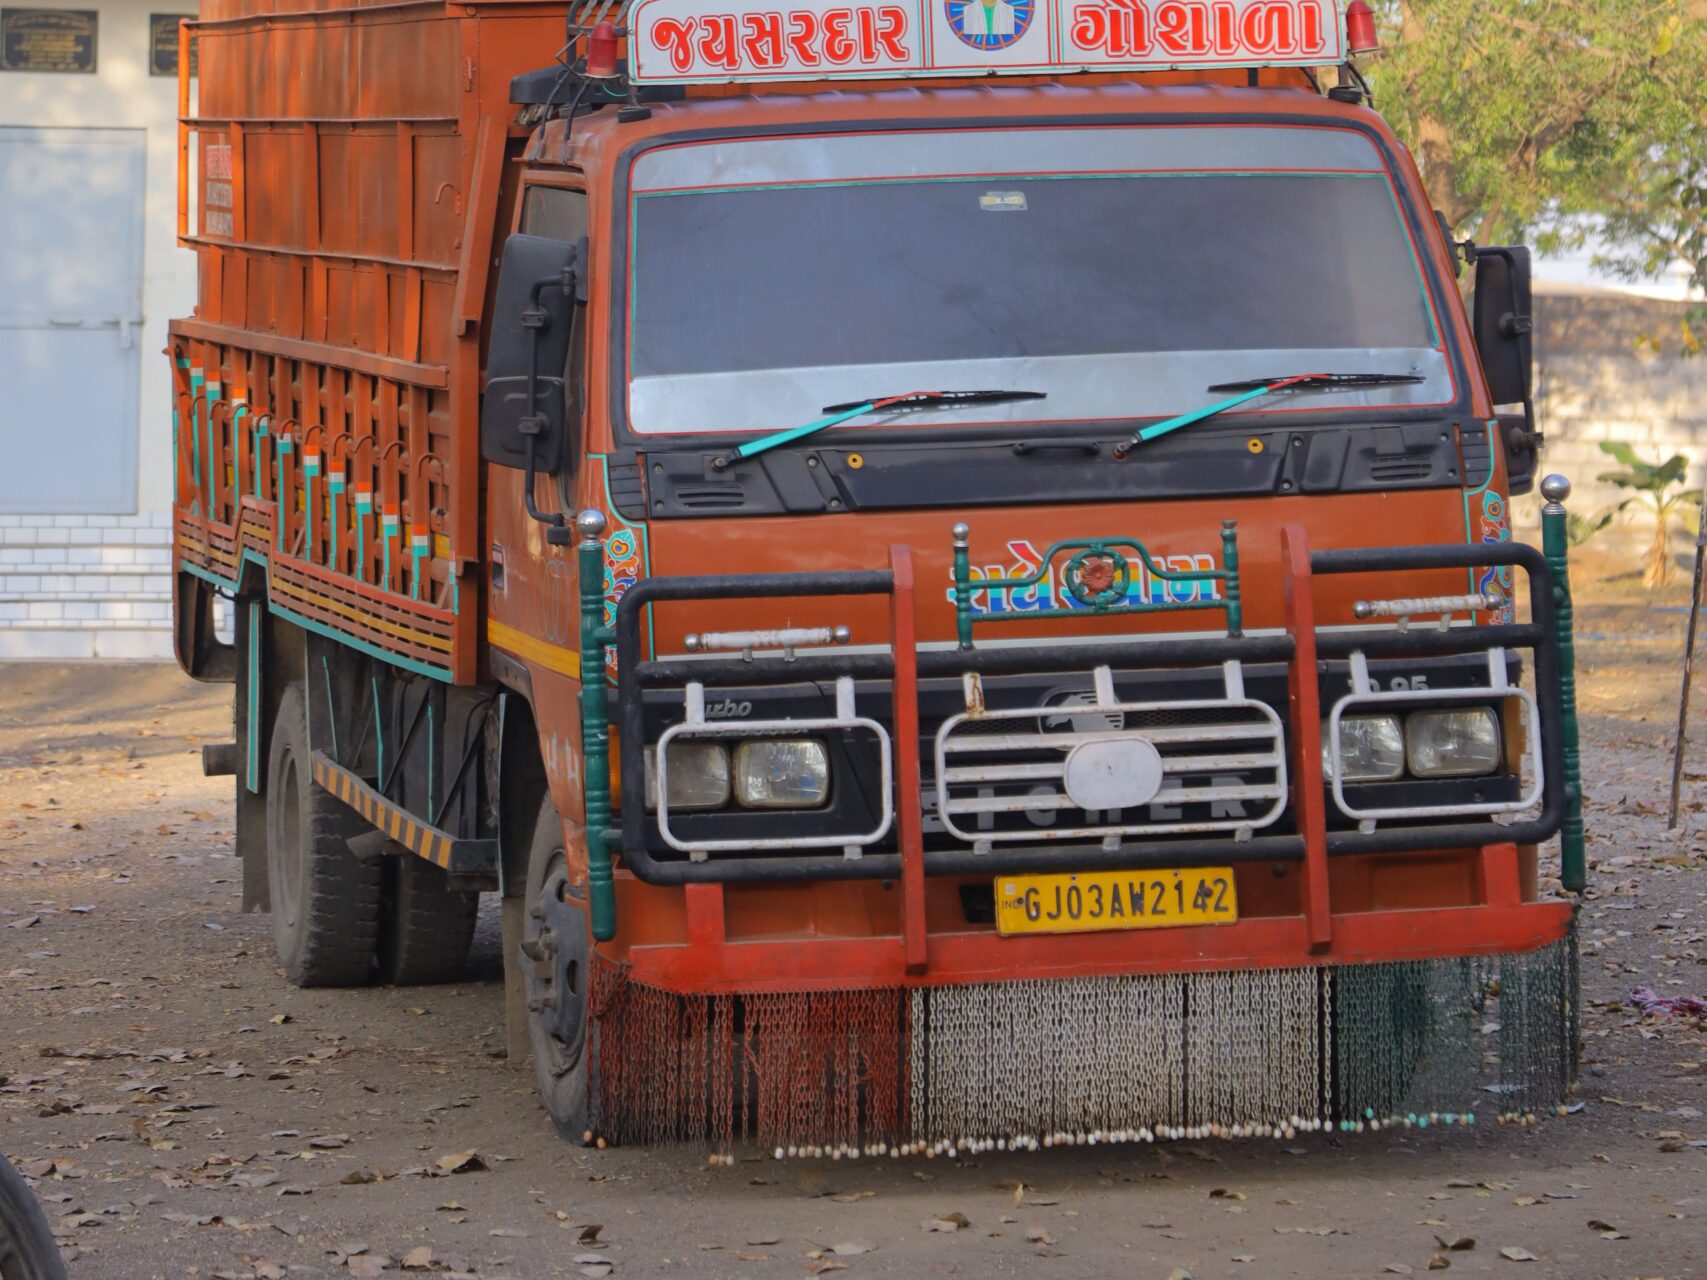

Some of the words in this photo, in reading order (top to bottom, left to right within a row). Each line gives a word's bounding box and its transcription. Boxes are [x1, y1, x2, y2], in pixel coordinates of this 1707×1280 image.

[683, 699, 752, 718] urbo
[919, 776, 1248, 834] EICER
[1024, 878, 1229, 921] GJ03AW2142
